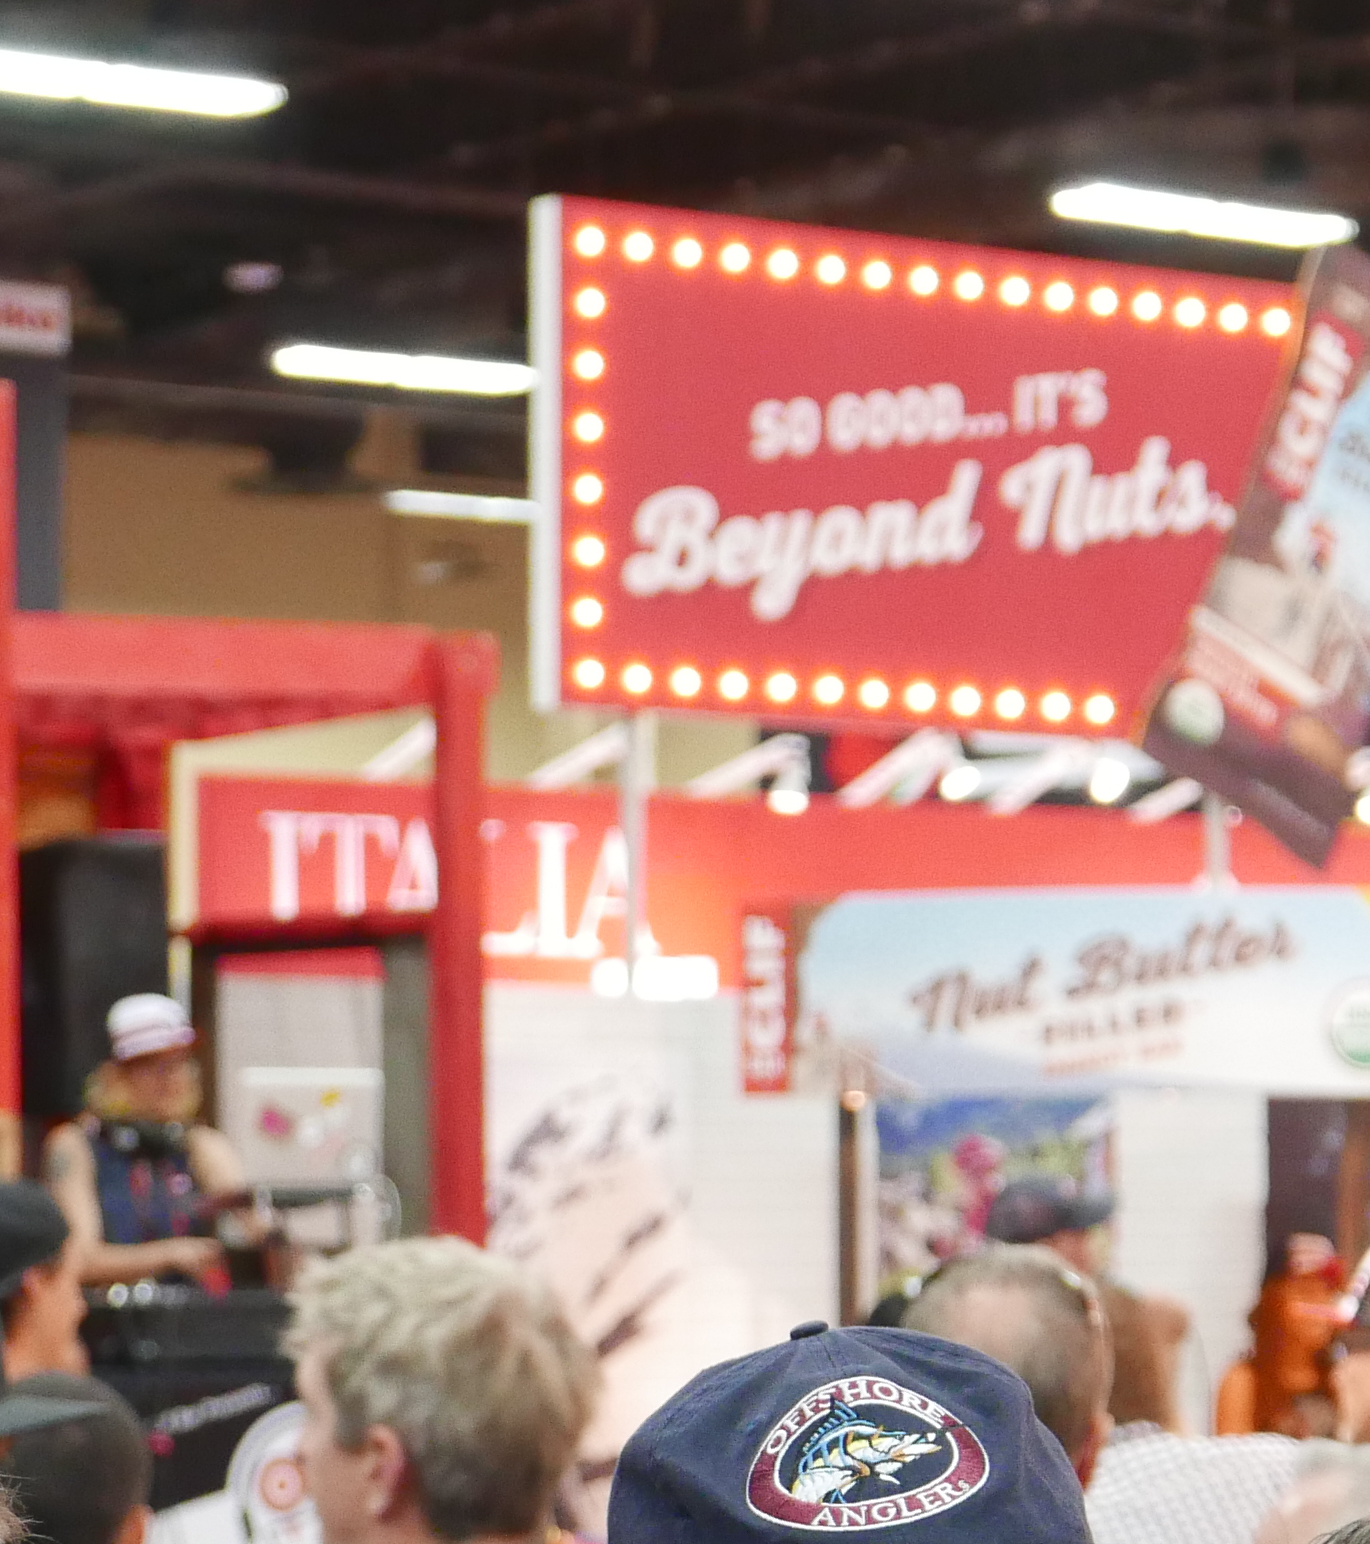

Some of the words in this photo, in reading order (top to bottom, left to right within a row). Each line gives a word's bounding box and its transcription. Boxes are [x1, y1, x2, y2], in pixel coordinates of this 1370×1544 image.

[747, 396, 822, 460] SO
[1013, 368, 1111, 432] IT'S
[621, 484, 984, 623] Beyond
[999, 434, 1238, 555] Nuts.
[259, 808, 662, 958] ITAIA
[765, 1377, 949, 1456] OFFSHORE
